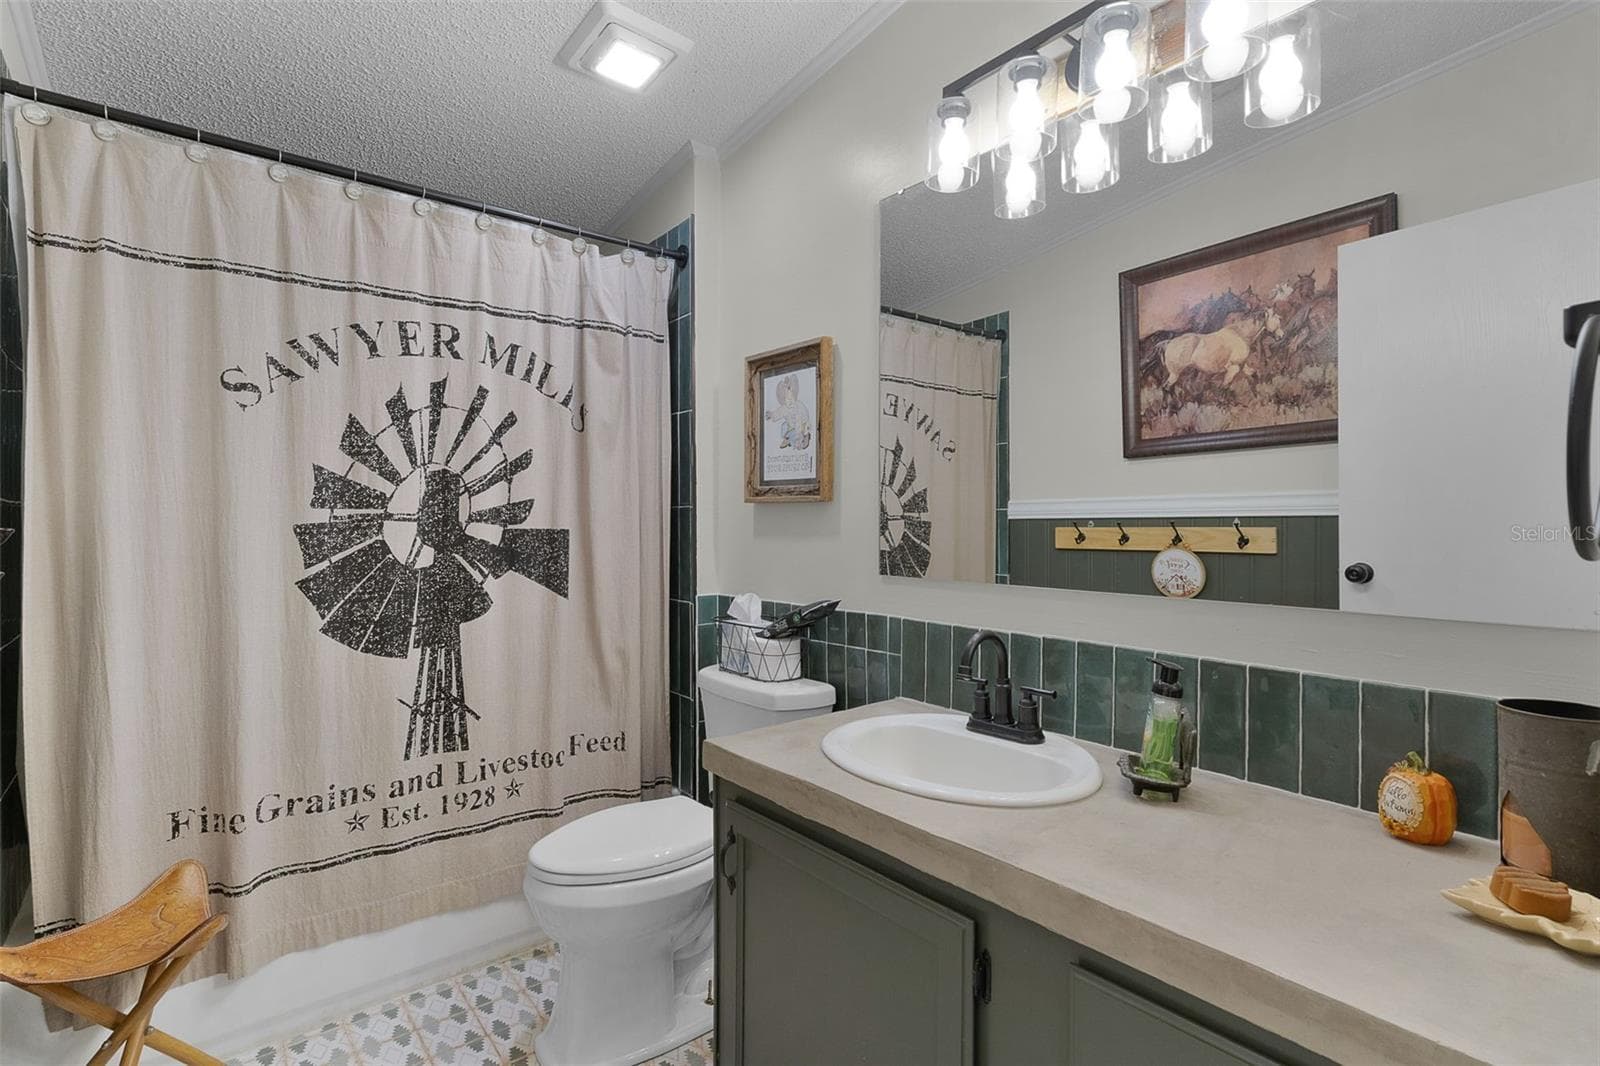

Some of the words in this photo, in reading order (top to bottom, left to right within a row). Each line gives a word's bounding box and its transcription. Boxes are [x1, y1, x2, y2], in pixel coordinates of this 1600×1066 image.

[220, 321, 464, 412] SAWYER
[166, 806, 247, 842] Fine
[256, 783, 376, 824] Grains
[389, 763, 443, 799] and
[455, 749, 565, 785] Livestoc
[569, 730, 627, 757] Feed
[381, 802, 428, 829] Est.
[440, 785, 497, 815] 1928
